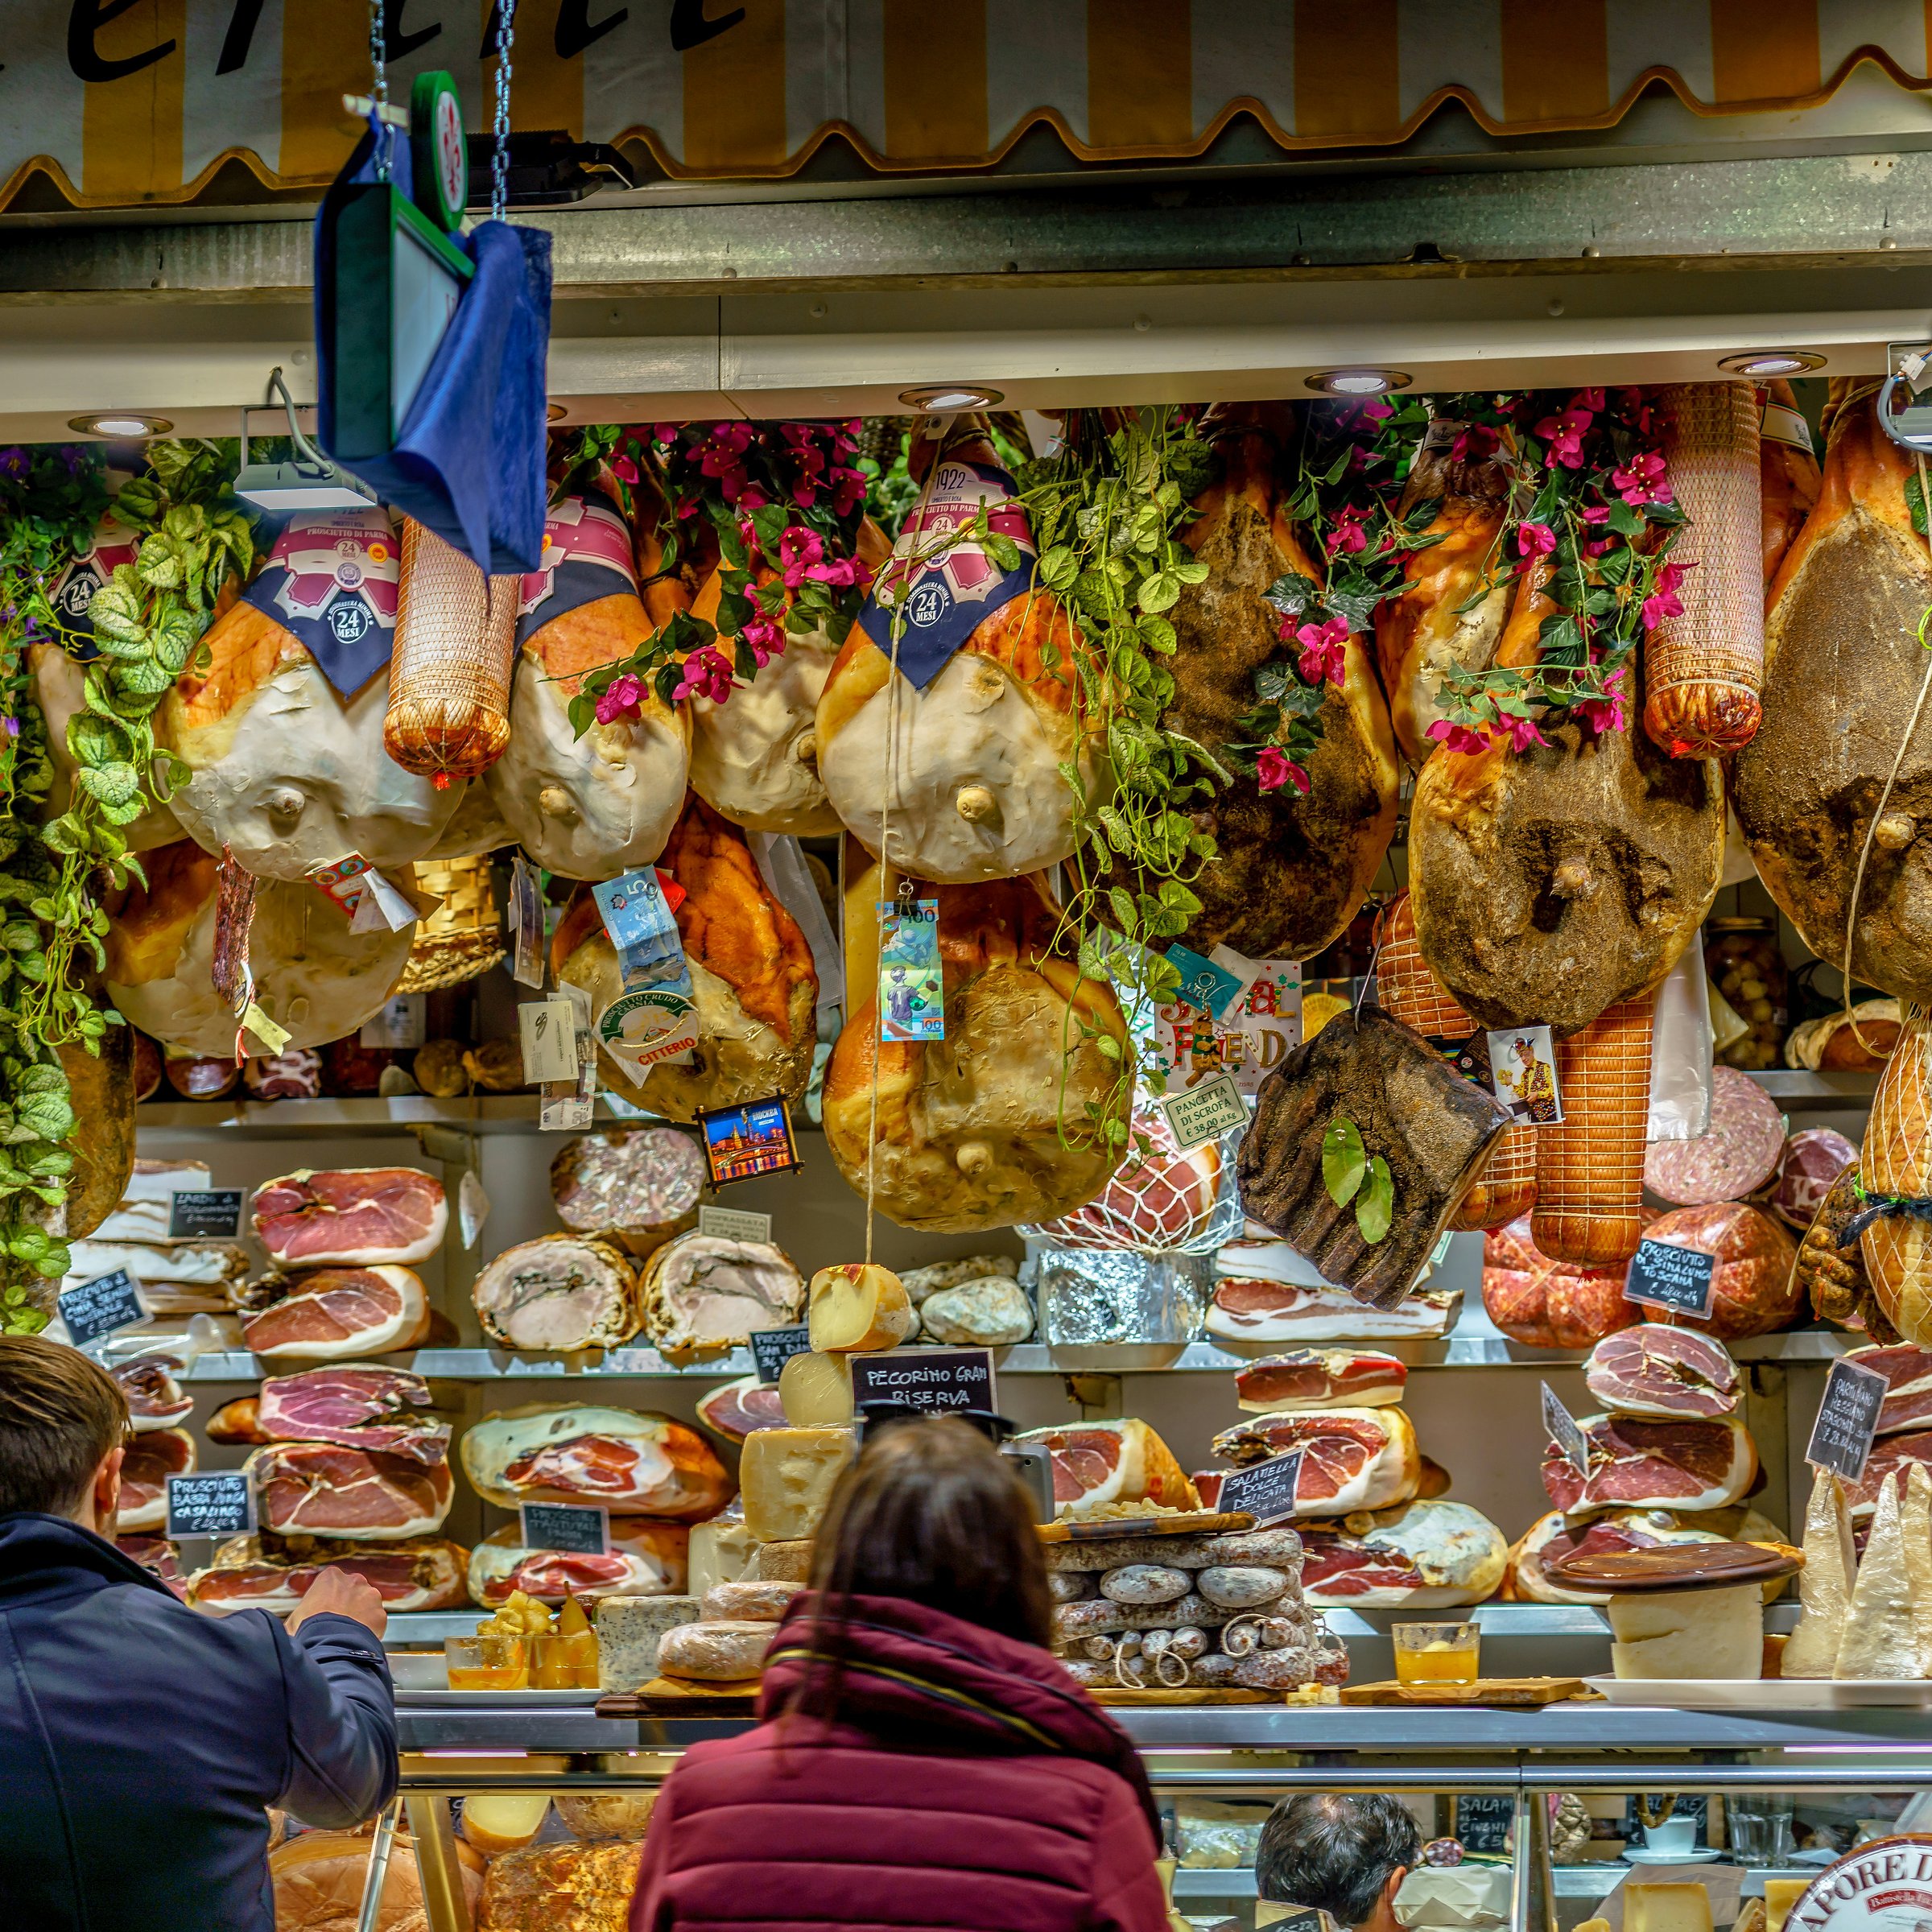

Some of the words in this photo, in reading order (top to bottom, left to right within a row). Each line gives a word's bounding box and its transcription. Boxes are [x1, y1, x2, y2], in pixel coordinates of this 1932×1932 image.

[935, 469, 966, 490] 1922
[911, 505, 948, 517] PRCIUTTO
[959, 505, 980, 513] PARM
[307, 528, 353, 538] PROSCIUTTO
[353, 530, 363, 538] DI
[364, 530, 388, 540] PARMA
[936, 519, 948, 530] 24
[341, 542, 356, 552] 24
[70, 580, 90, 603] 24
[916, 592, 937, 612] 24
[336, 610, 360, 628] 24
[916, 610, 937, 622] MESI
[336, 627, 360, 638] MESI
[625, 879, 646, 895] 5
[906, 910, 935, 923] 100
[601, 995, 643, 1028] PROSCIUTTO
[644, 994, 679, 1004] CRUDO
[920, 1020, 941, 1030] 100
[638, 1037, 696, 1066] CITTERIO
[1175, 1086, 1228, 1116] PANCETTA
[1180, 1115, 1193, 1127] DI
[1194, 1098, 1232, 1121] SCROFA
[1186, 1128, 1193, 1137] €
[1220, 1115, 1227, 1123] al
[1641, 1241, 1706, 1266] PROSCIUTTO
[867, 1367, 952, 1386] PECORINO
[955, 1365, 988, 1382] GRAN
[892, 1389, 970, 1406] RISERVA
[1226, 1457, 1298, 1492] SALAMELLA
[1241, 1476, 1280, 1496] DOLCE
[1232, 1484, 1287, 1510] DELICATA
[1459, 1796, 1513, 1813] SALAM
[1459, 1823, 1506, 1833] CINGHI
